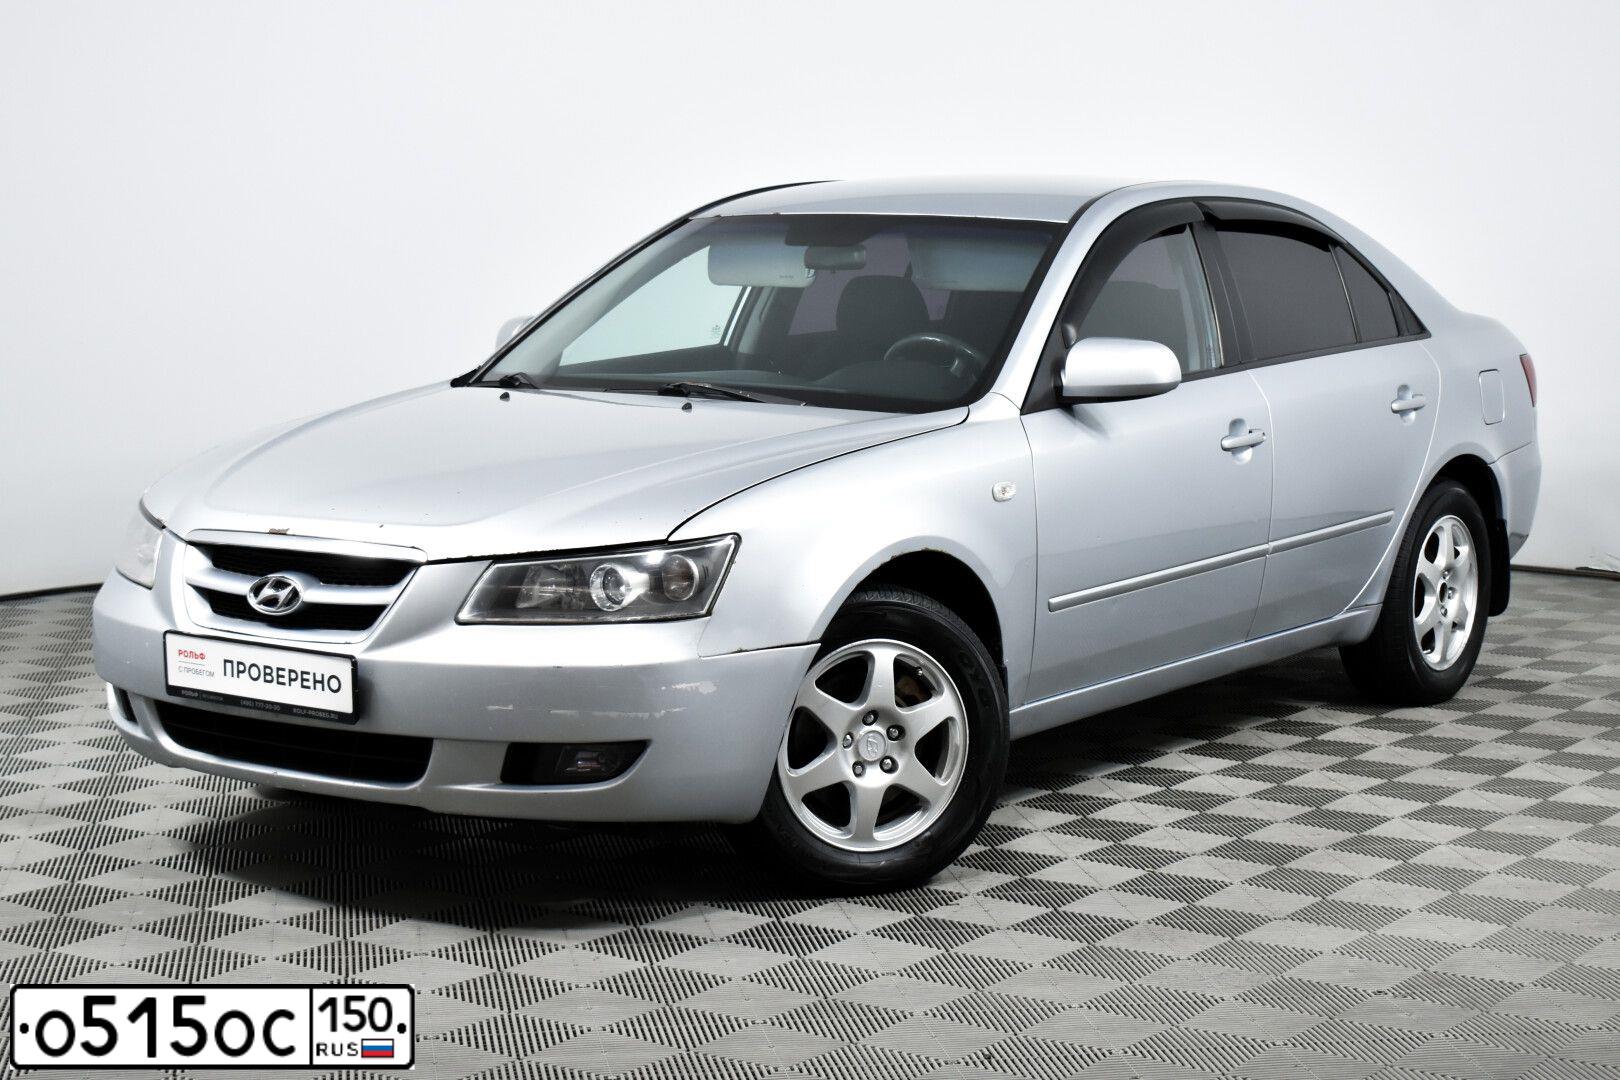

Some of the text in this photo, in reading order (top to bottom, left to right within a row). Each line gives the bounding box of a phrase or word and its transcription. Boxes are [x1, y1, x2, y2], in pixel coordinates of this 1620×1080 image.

[178, 649, 206, 660] РОЛЬФ
[184, 667, 215, 678] ПРОБЕГОМ
[223, 659, 342, 694] ПРОВЕРЕНО
